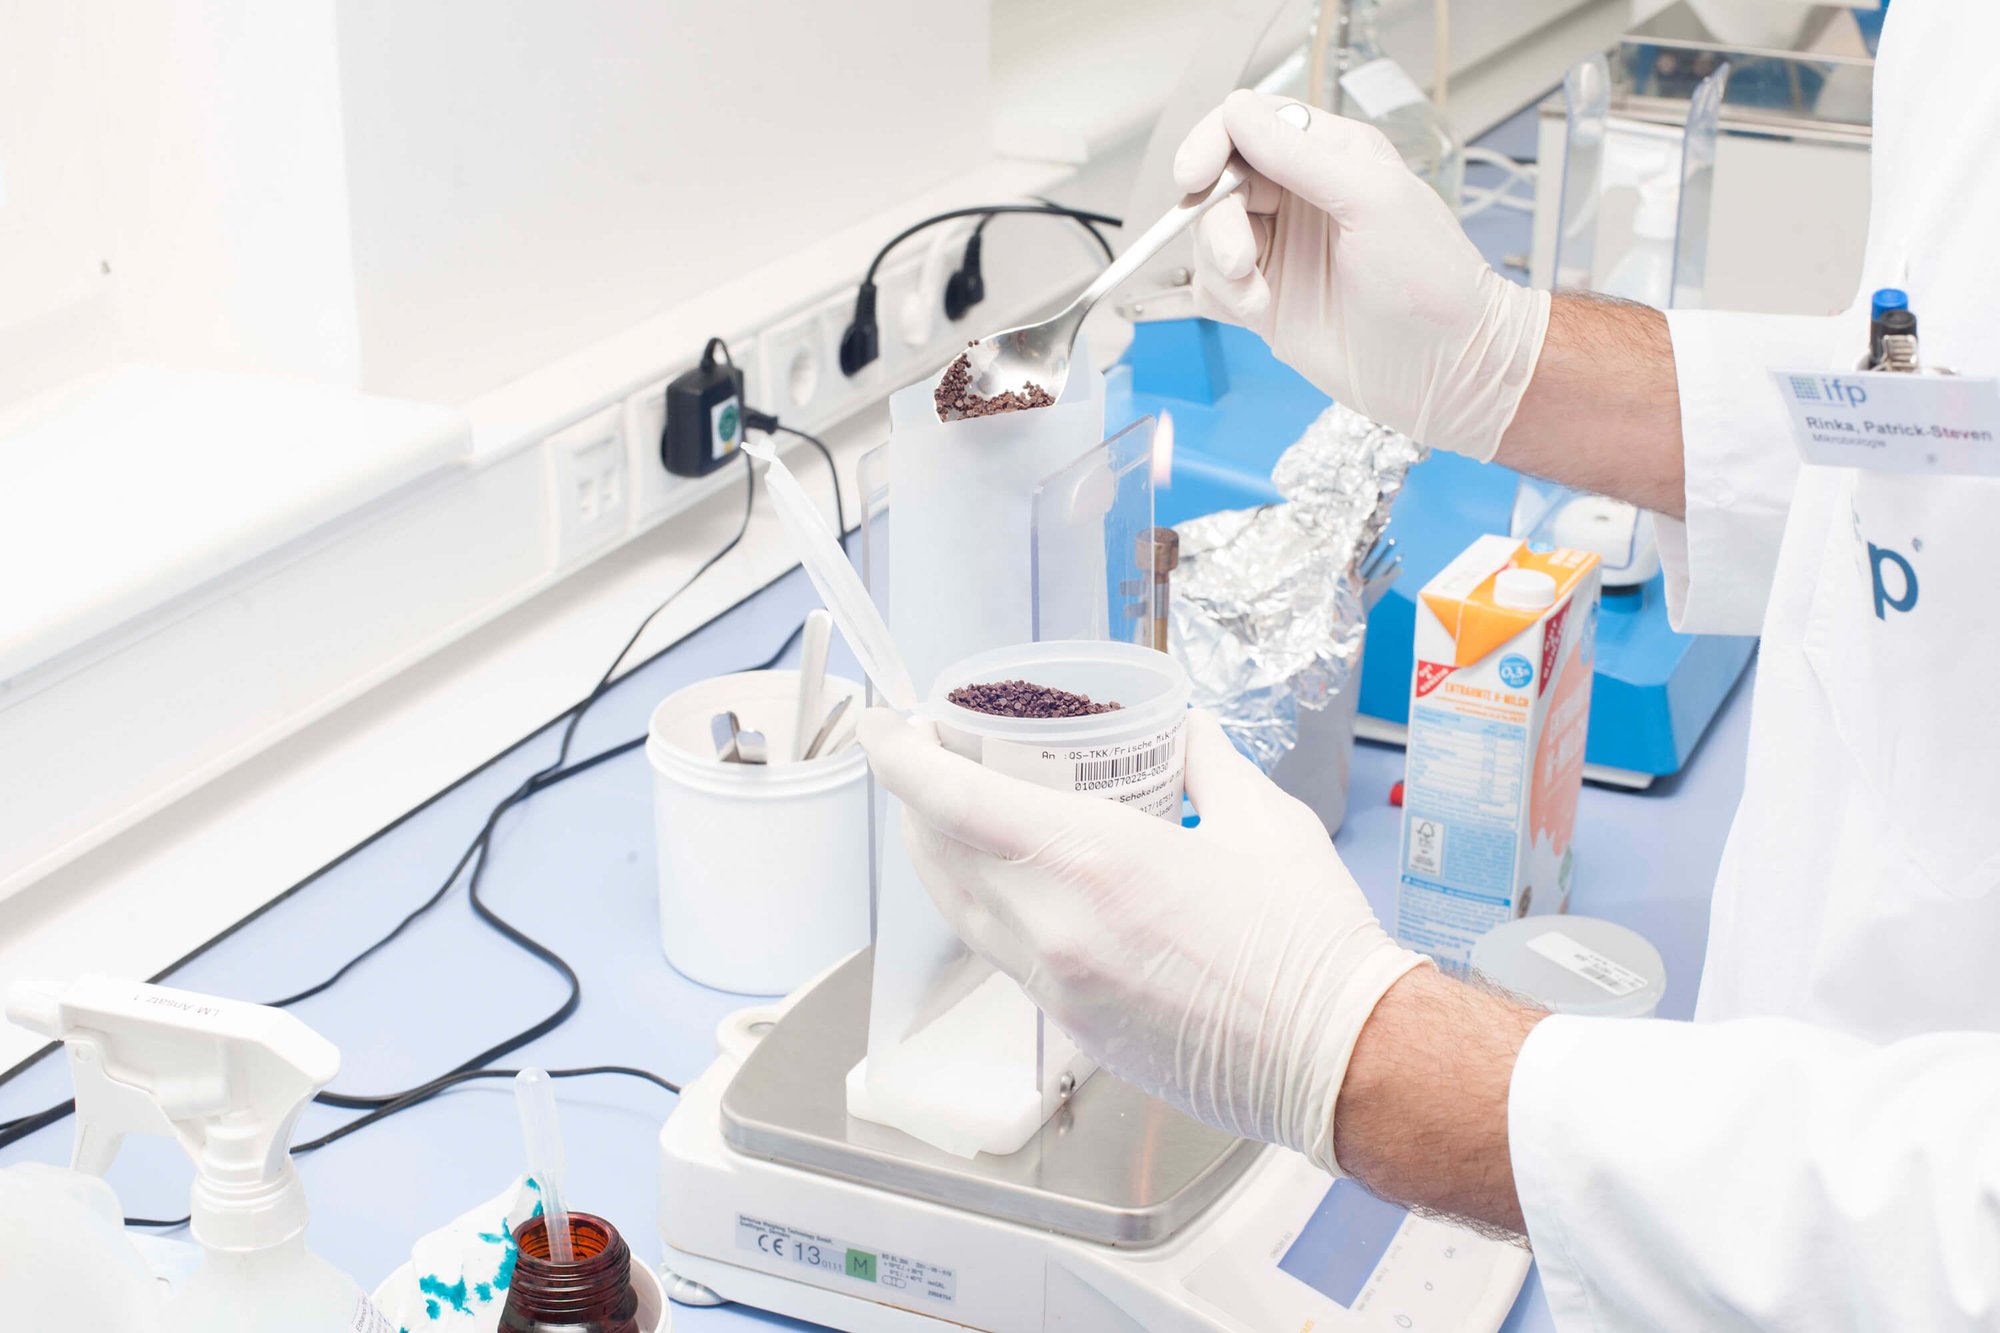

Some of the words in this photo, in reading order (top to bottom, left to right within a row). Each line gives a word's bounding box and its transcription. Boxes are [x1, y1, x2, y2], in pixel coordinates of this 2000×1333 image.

[1822, 378, 1867, 407] ifp
[1806, 416, 1861, 433] Rinka,
[1864, 420, 1993, 442] Patrick-Steven
[1042, 751, 1056, 760] An
[795, 1242, 821, 1266] 13
[854, 1256, 869, 1276] M
